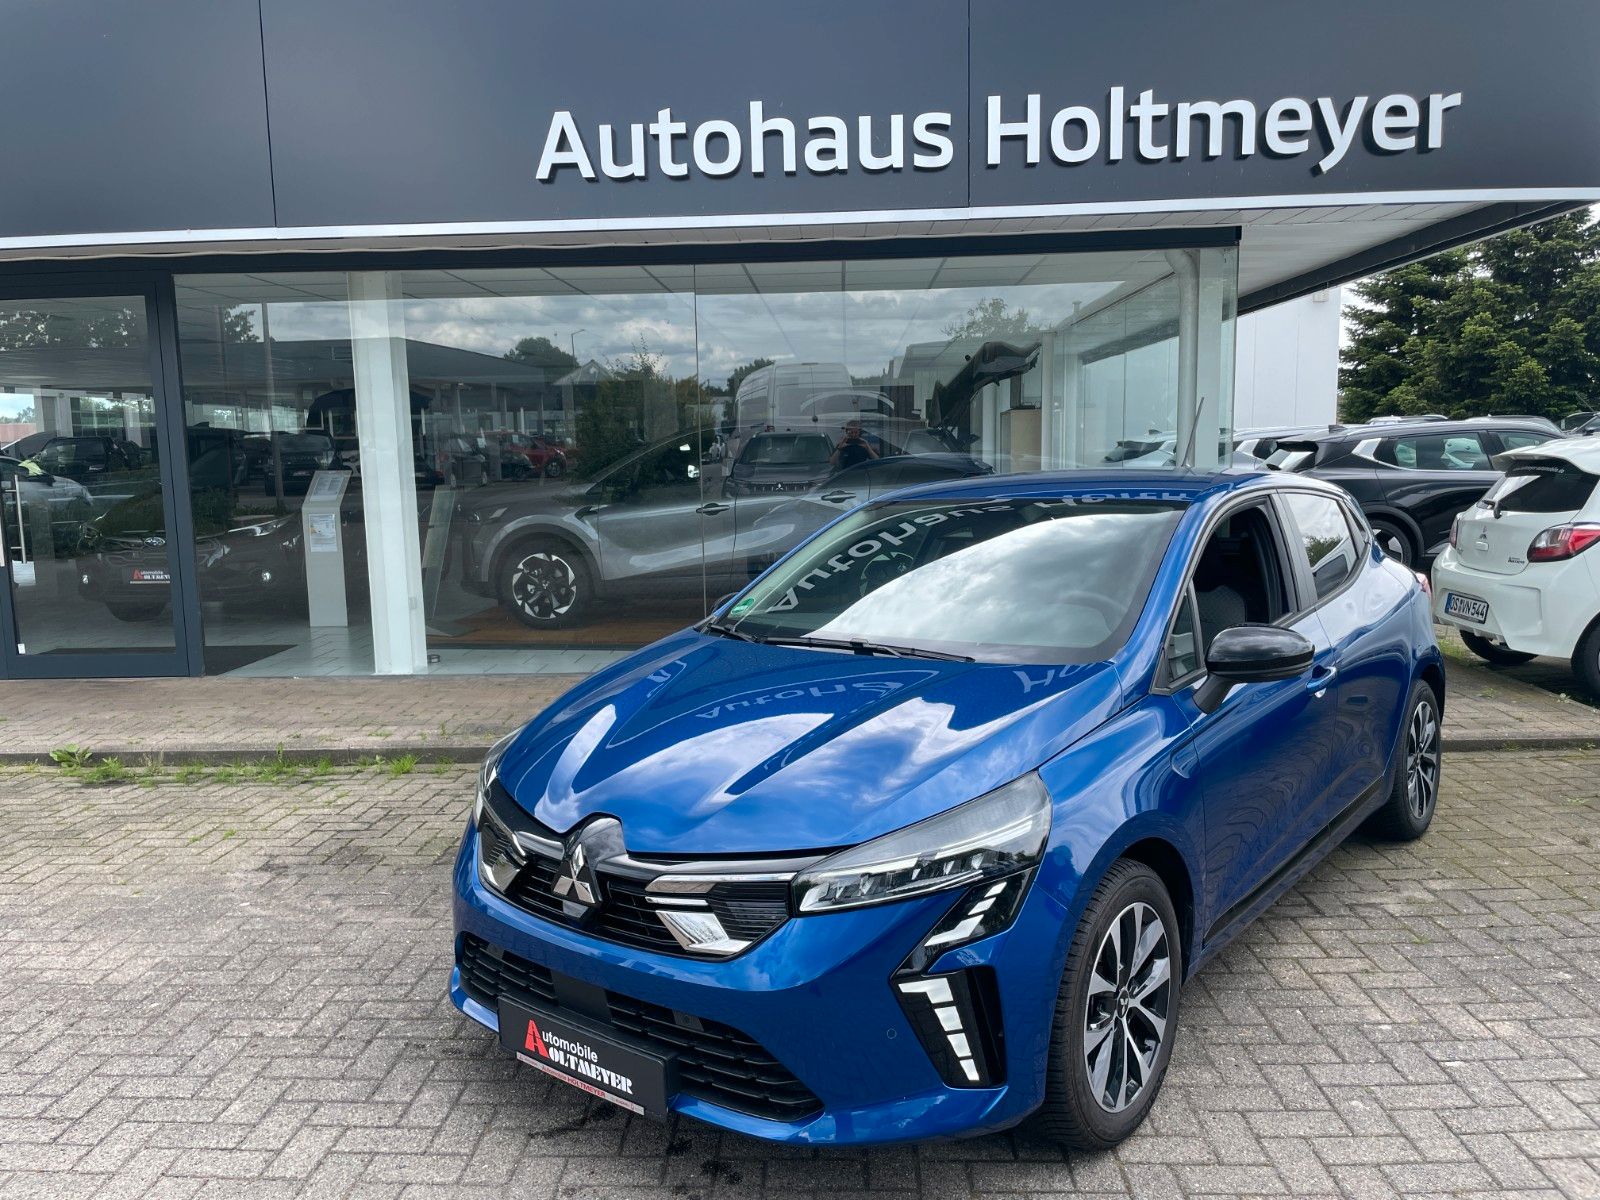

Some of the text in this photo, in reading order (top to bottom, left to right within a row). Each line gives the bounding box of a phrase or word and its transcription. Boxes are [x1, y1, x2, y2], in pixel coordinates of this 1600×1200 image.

[536, 86, 1462, 182] Autohaus Holtmeyer
[524, 1019, 598, 1063] Automobile
